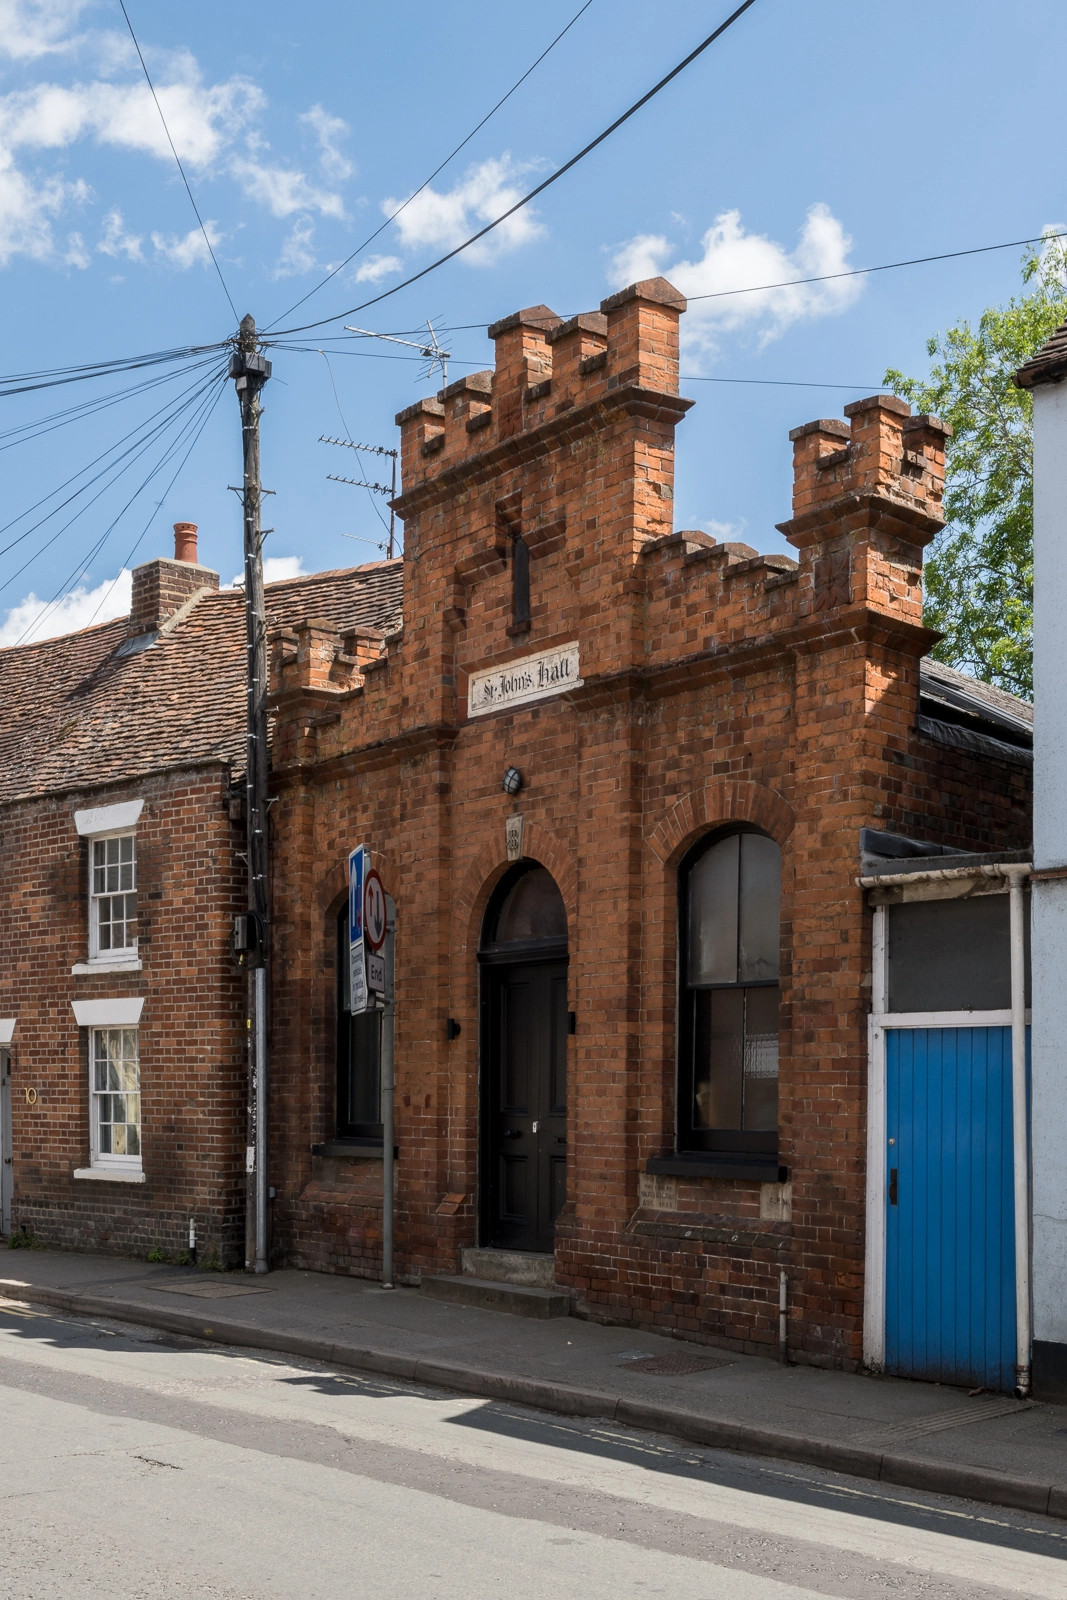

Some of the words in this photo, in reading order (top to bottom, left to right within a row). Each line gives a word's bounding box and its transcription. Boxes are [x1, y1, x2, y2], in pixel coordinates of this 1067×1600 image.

[498, 671, 532, 698] John's
[537, 658, 570, 688] Hall
[371, 964, 383, 982] End
[24, 1087, 37, 1104] 10
